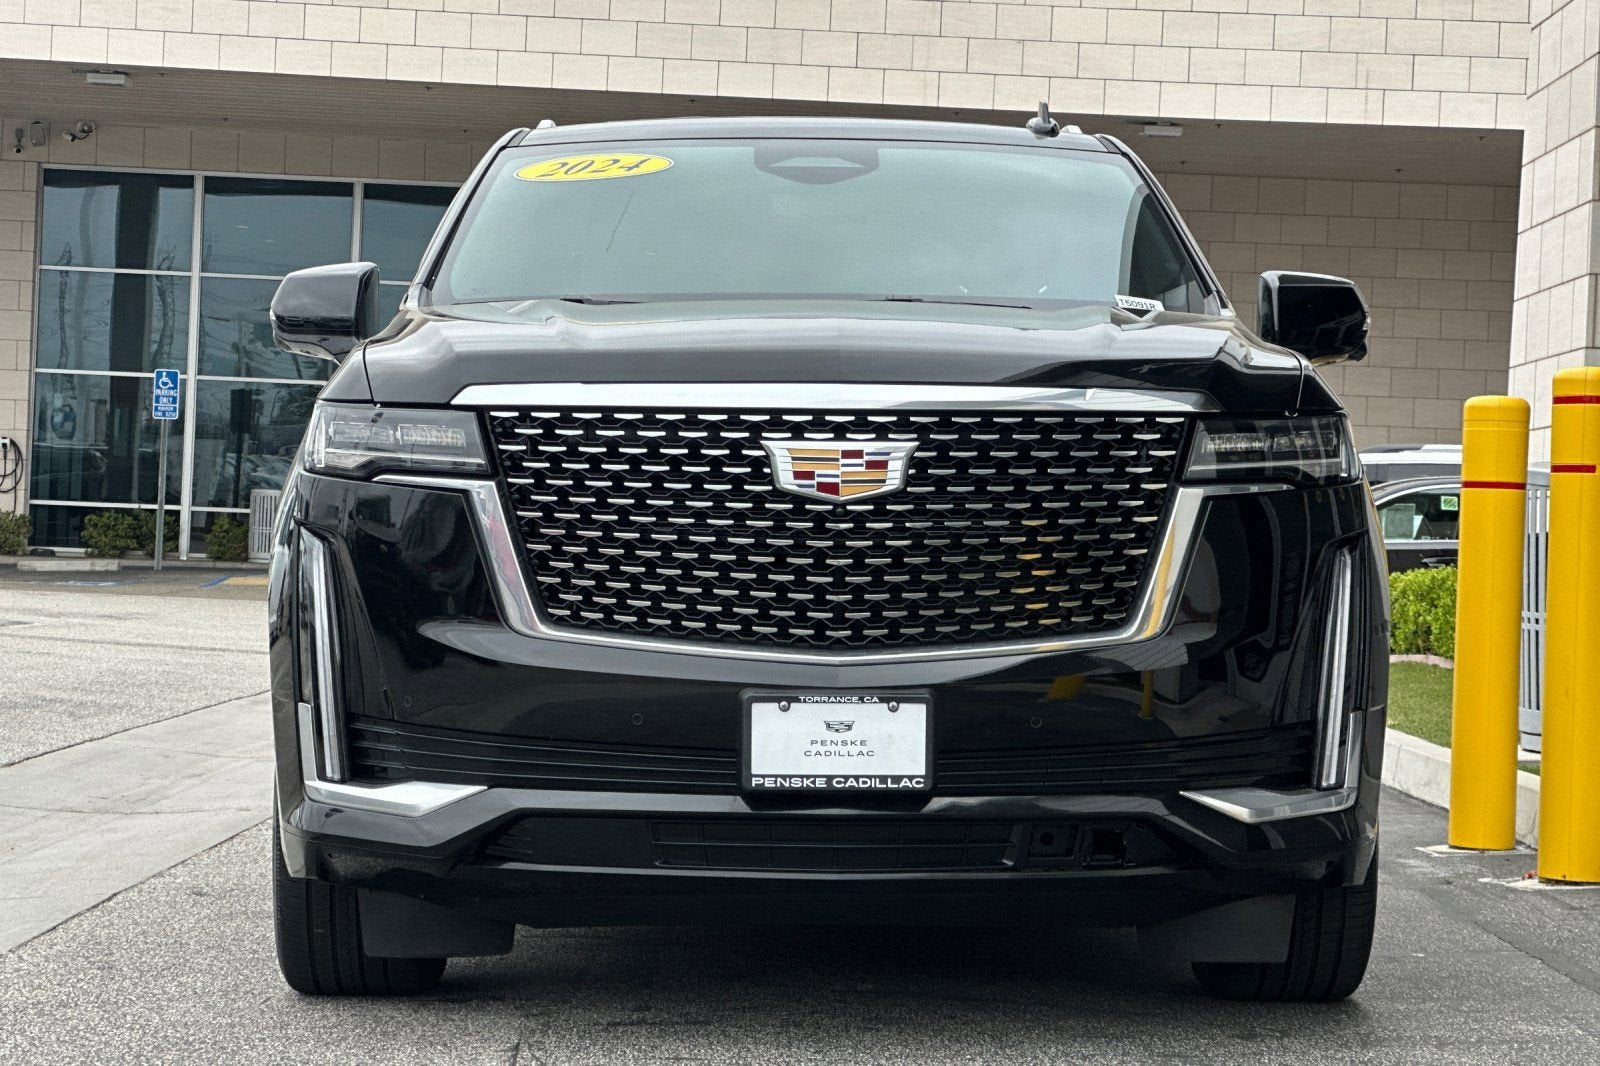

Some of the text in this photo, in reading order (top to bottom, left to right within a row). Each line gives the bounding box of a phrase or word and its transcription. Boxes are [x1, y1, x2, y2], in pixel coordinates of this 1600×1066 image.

[535, 157, 653, 178] 2024
[155, 388, 178, 397] PARKING
[159, 397, 173, 405] ONLY
[798, 696, 862, 704] TORRANCE,
[810, 739, 868, 747] PENSKE
[751, 777, 925, 788] PENSKE CADILLAC
